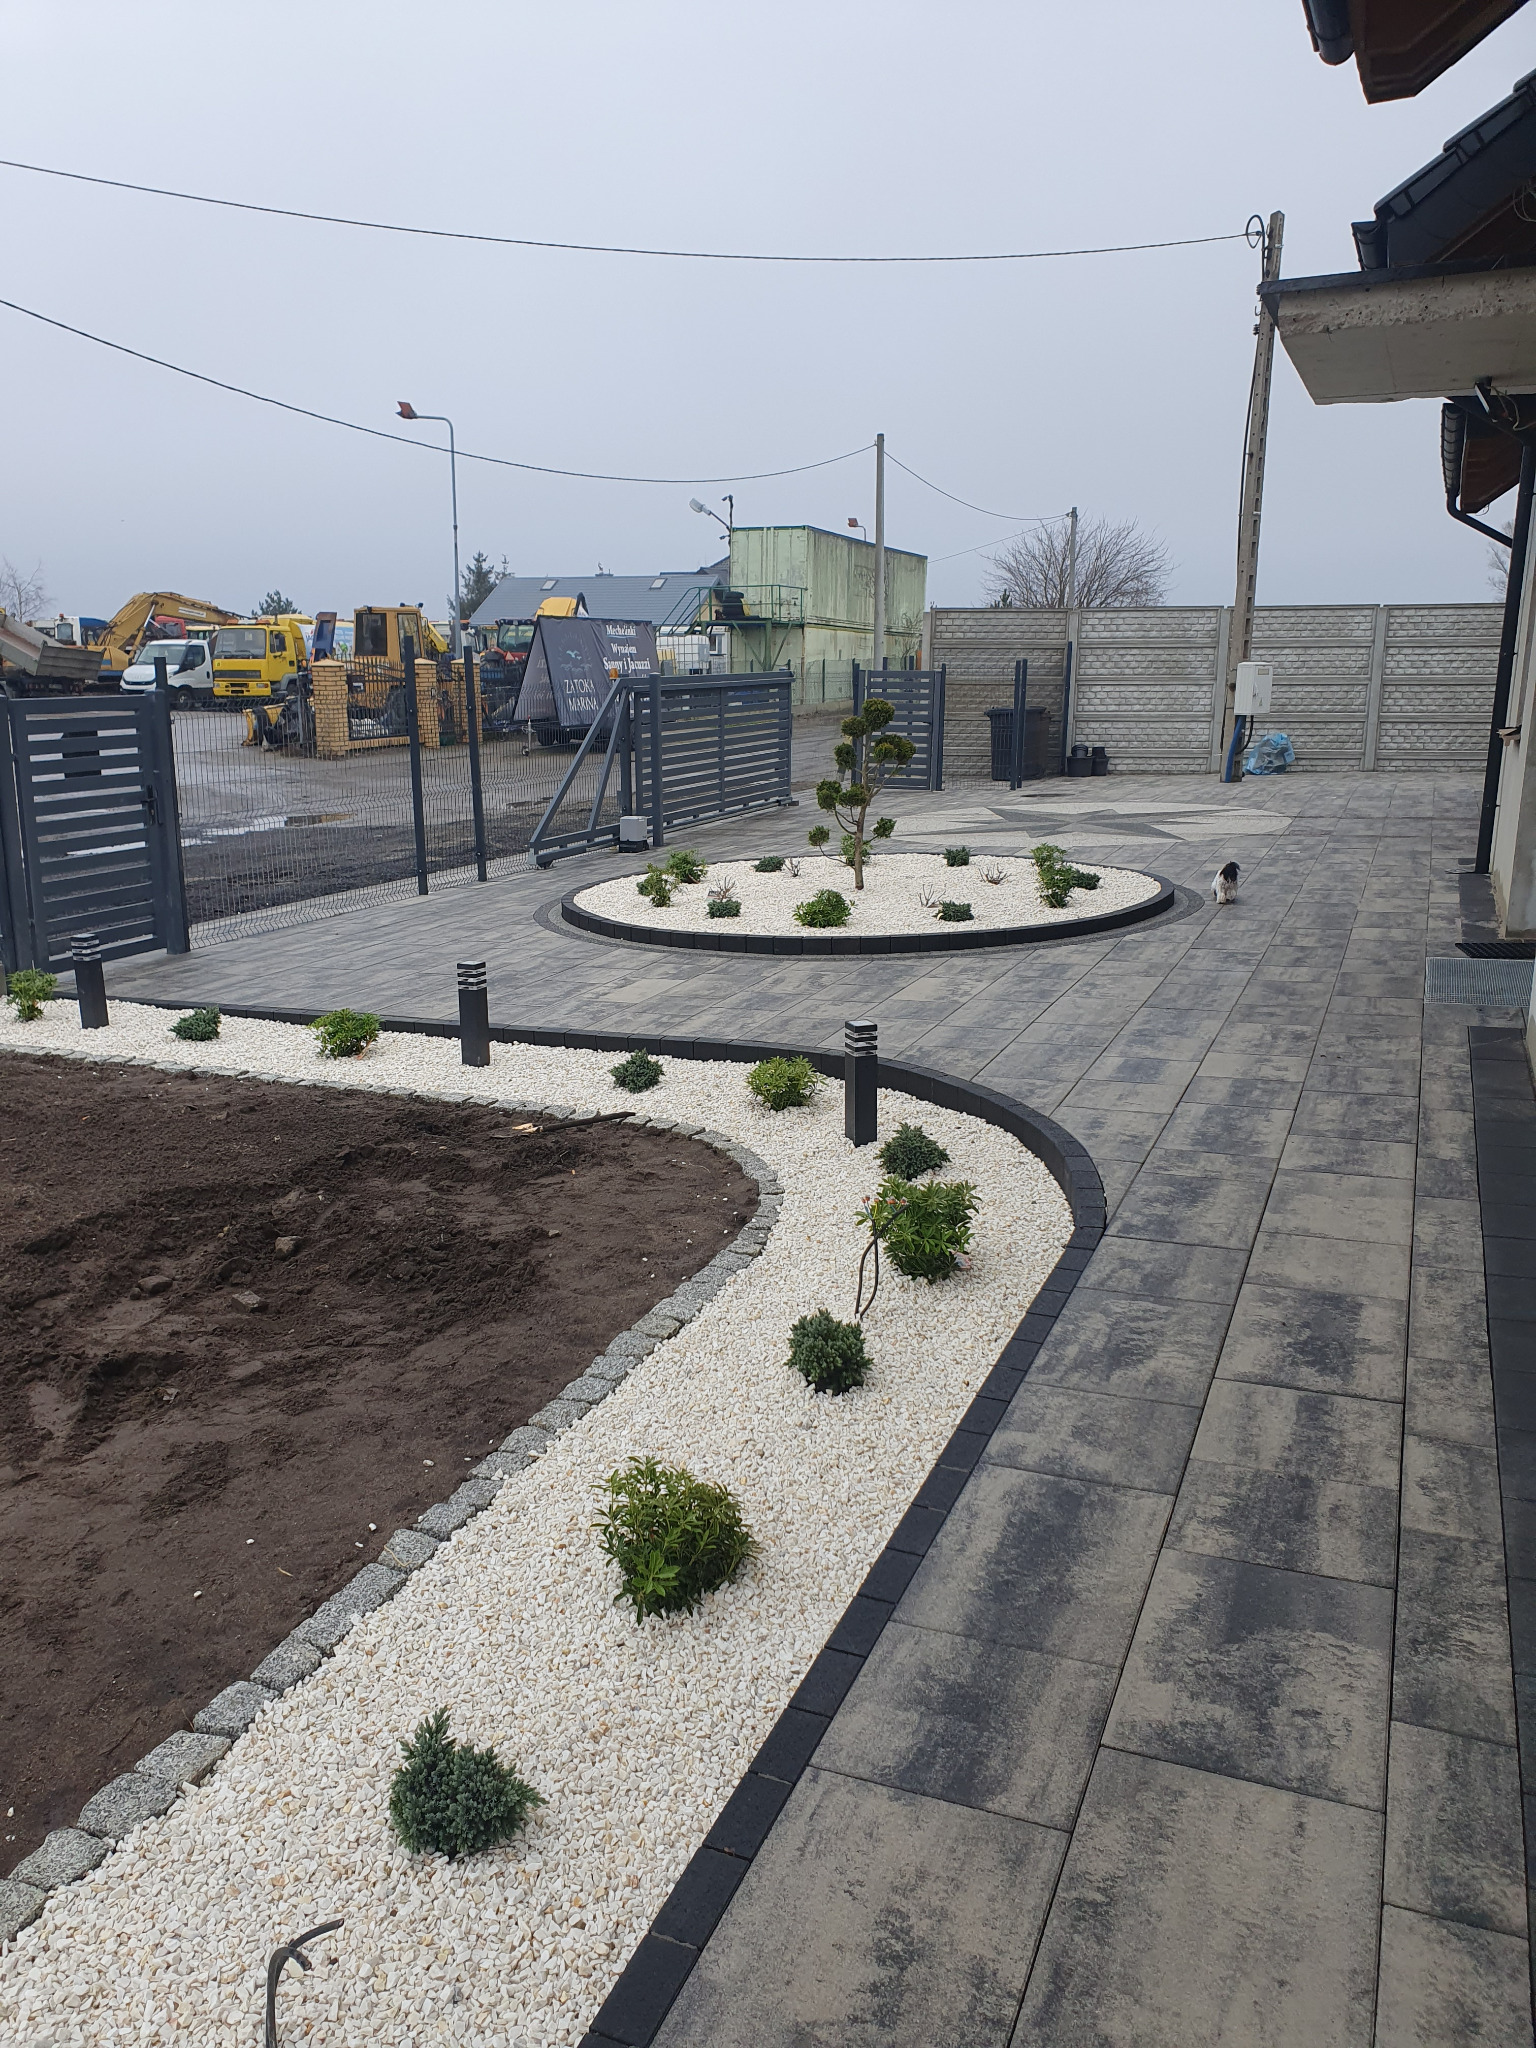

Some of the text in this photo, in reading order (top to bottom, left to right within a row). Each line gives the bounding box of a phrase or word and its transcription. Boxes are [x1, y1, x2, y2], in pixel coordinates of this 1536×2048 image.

[627, 657, 651, 673] Jacuzzi
[564, 679, 595, 693] ZATOKA
[569, 697, 599, 711] MARINA
